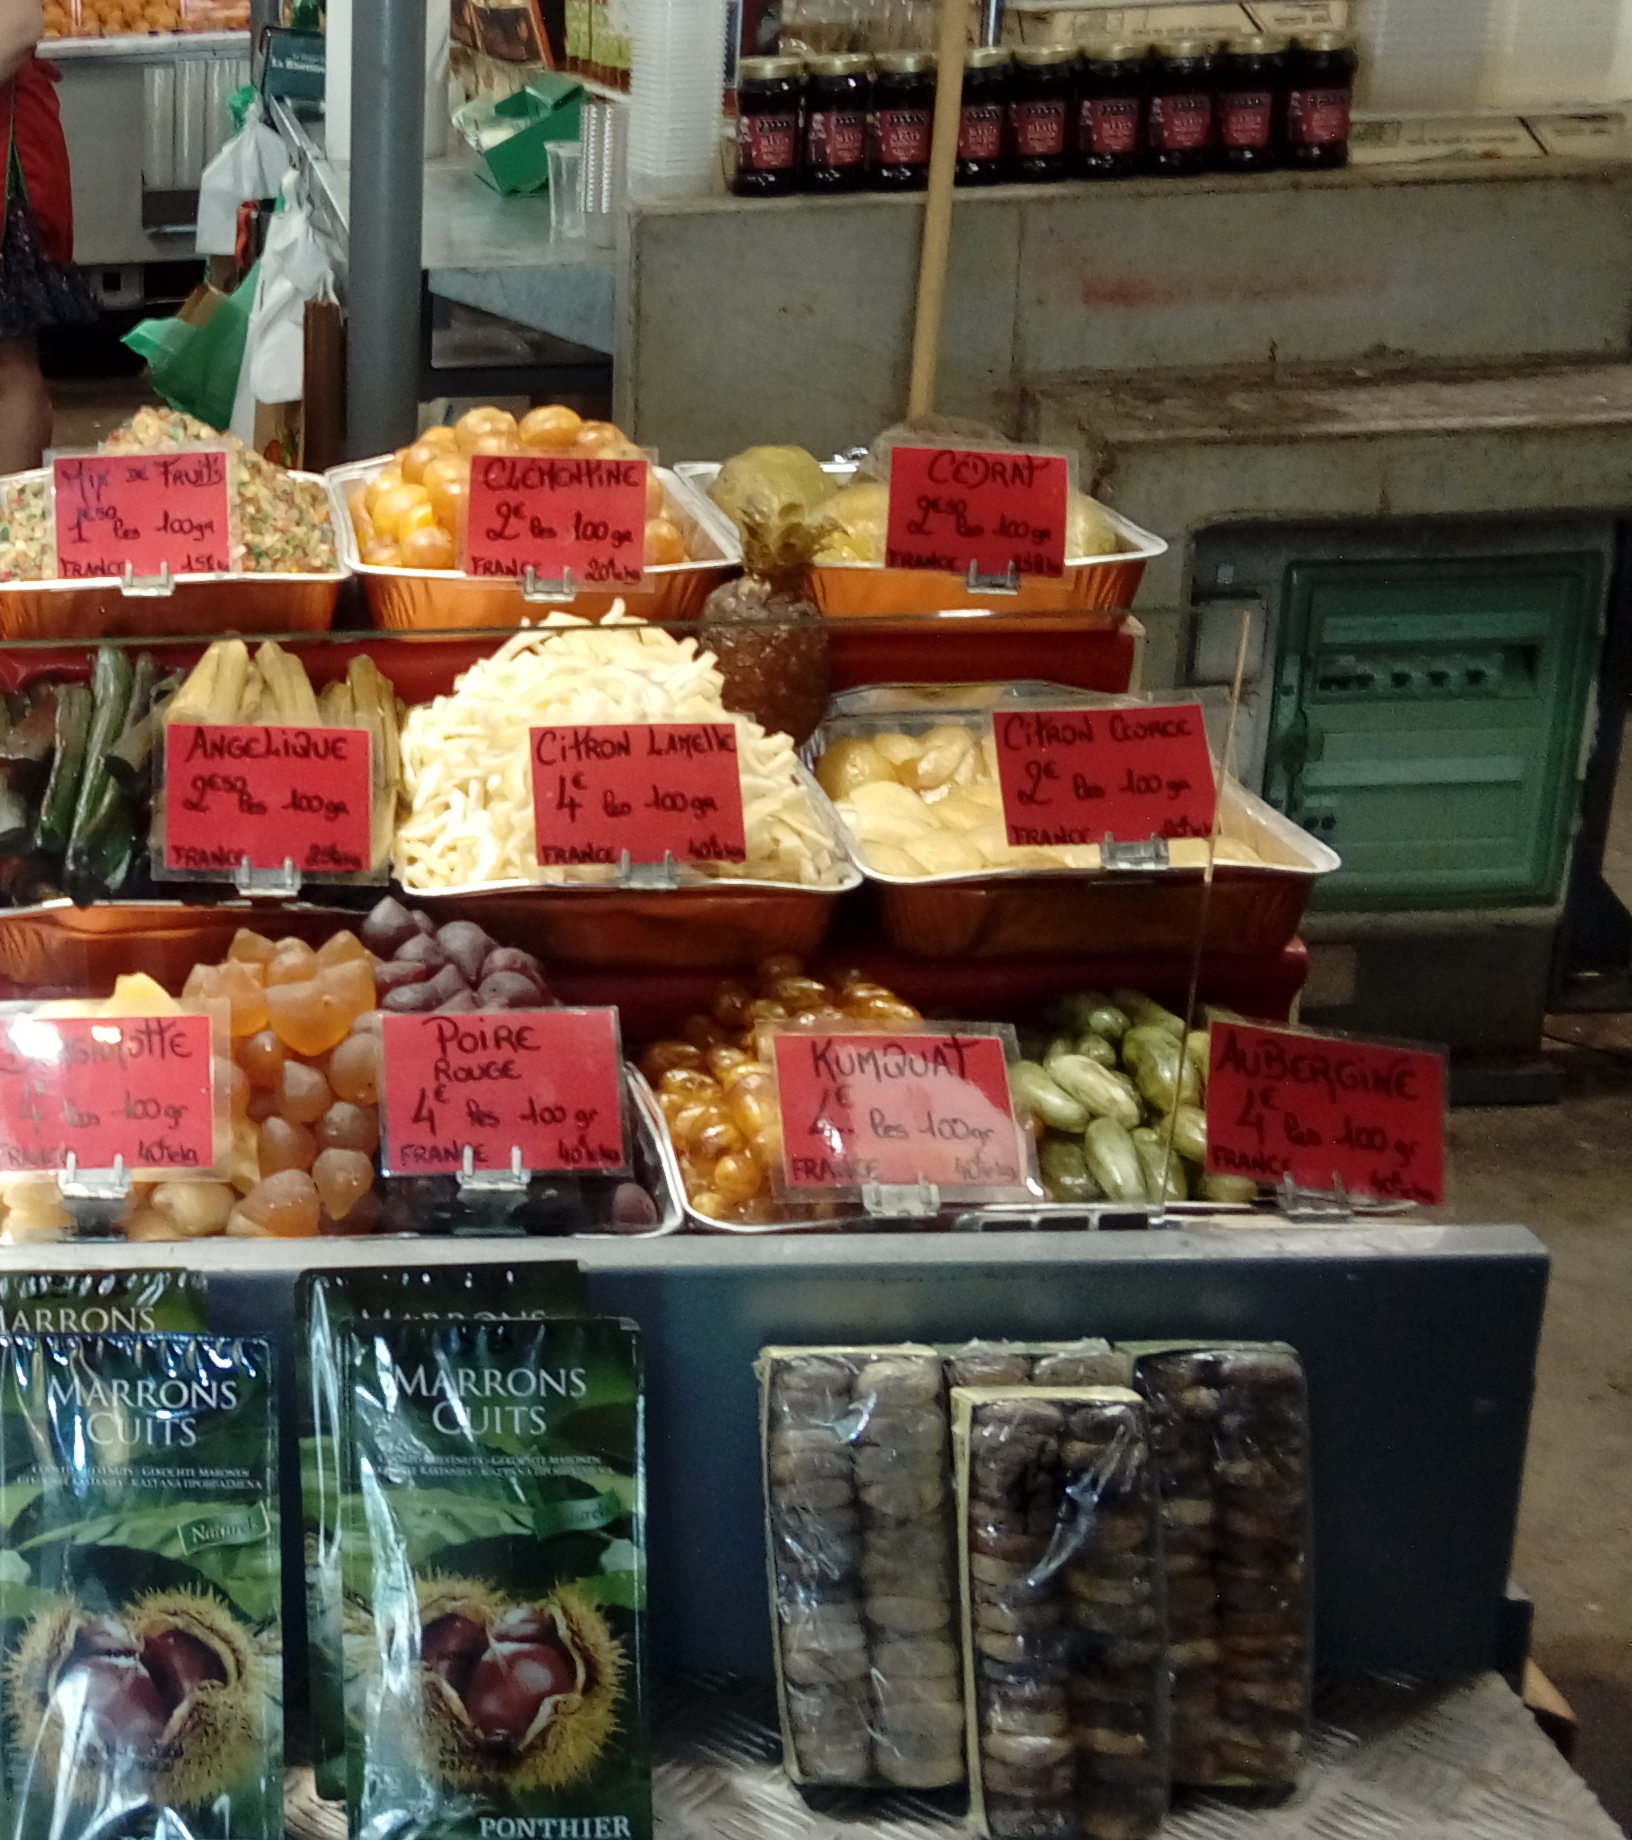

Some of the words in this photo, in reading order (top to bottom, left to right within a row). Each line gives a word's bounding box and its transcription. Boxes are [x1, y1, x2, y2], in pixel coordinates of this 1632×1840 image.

[184, 726, 348, 762] ANGELIQUE
[536, 727, 632, 766] CITRON
[1004, 712, 1095, 752] CITRON
[421, 1017, 541, 1057] POIRE
[433, 1057, 522, 1082] ROUGE
[811, 1034, 979, 1083] KUMQUAT
[1216, 1030, 1419, 1103] AUBERGINE
[1212, 1145, 1293, 1174] FRANCE
[49, 1379, 239, 1411] MARRONS
[395, 1365, 587, 1398] MARRONS
[86, 1411, 197, 1448] CUITS
[431, 1403, 548, 1436] CUITS
[479, 1815, 632, 1839] PONTHIER
